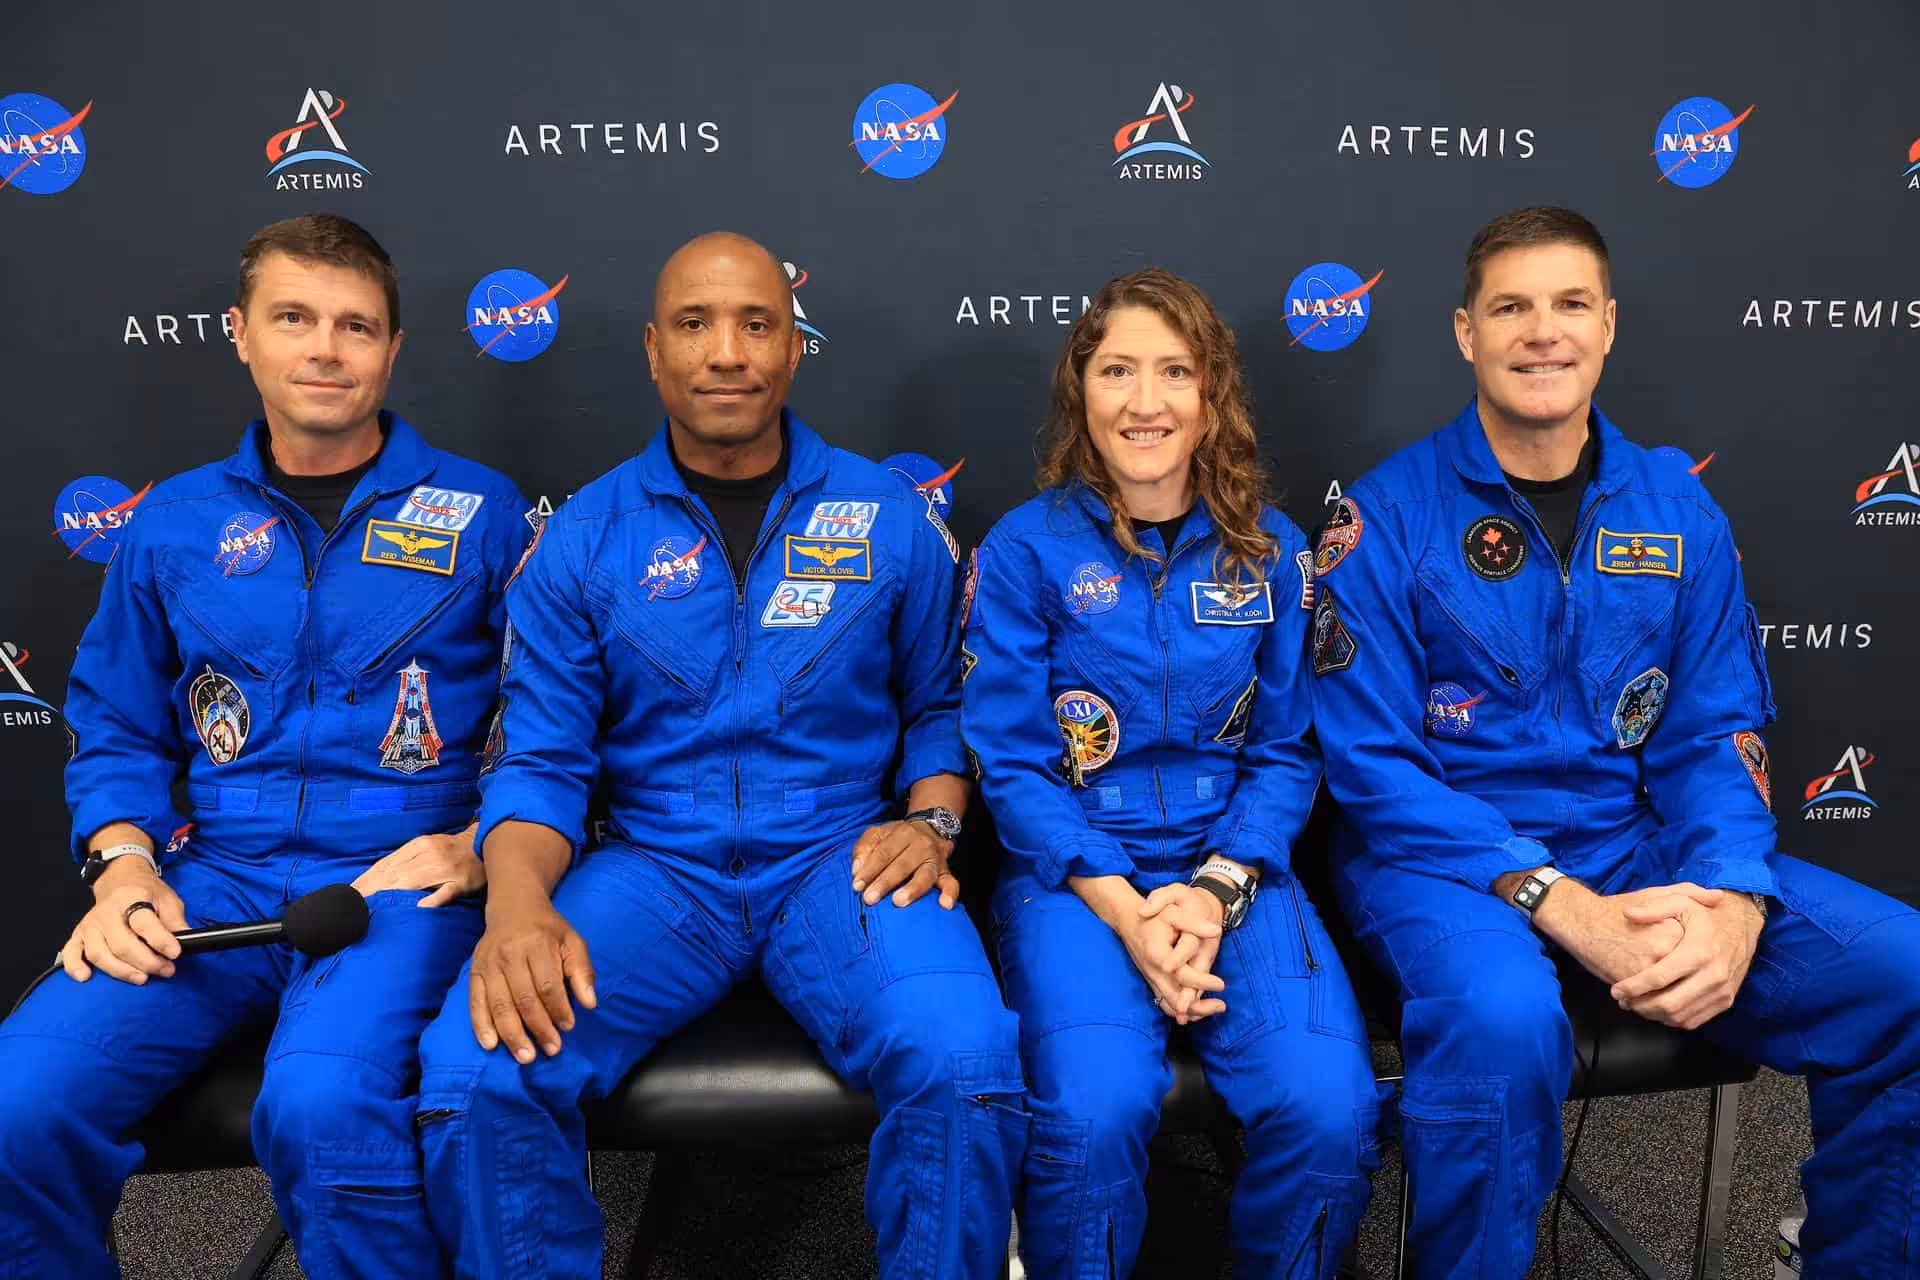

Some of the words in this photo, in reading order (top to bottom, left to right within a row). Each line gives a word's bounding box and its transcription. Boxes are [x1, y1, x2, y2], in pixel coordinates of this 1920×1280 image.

[505, 121, 719, 156] ARTEMIS
[861, 122, 940, 141] NASA
[0, 134, 81, 154] NASA
[1338, 124, 1535, 159] ARTEMIS
[1662, 133, 1733, 152] NASA
[276, 172, 363, 190] ARTEMIS
[1119, 163, 1202, 180] ARTEMIS
[474, 306, 553, 325] NASA
[1292, 298, 1364, 317] NASA
[1743, 300, 1920, 329] ARTEMIS
[404, 489, 476, 528] 100
[808, 503, 875, 537] 100
[220, 531, 270, 553] NASA
[381, 551, 398, 561] REID
[401, 553, 436, 567] WISEMAN
[647, 557, 700, 579] NASA
[1612, 560, 1635, 569] JEREMY
[1640, 560, 1666, 570] HANSEN
[803, 566, 826, 575] VICTOR
[829, 567, 855, 576] GLOVER
[1072, 582, 1118, 598] NASA
[771, 586, 824, 620] 25
[0, 710, 52, 726] EMIS
[1064, 701, 1091, 718] LXI
[212, 733, 232, 754] XL
[1804, 806, 1872, 820] ARTEMIS
